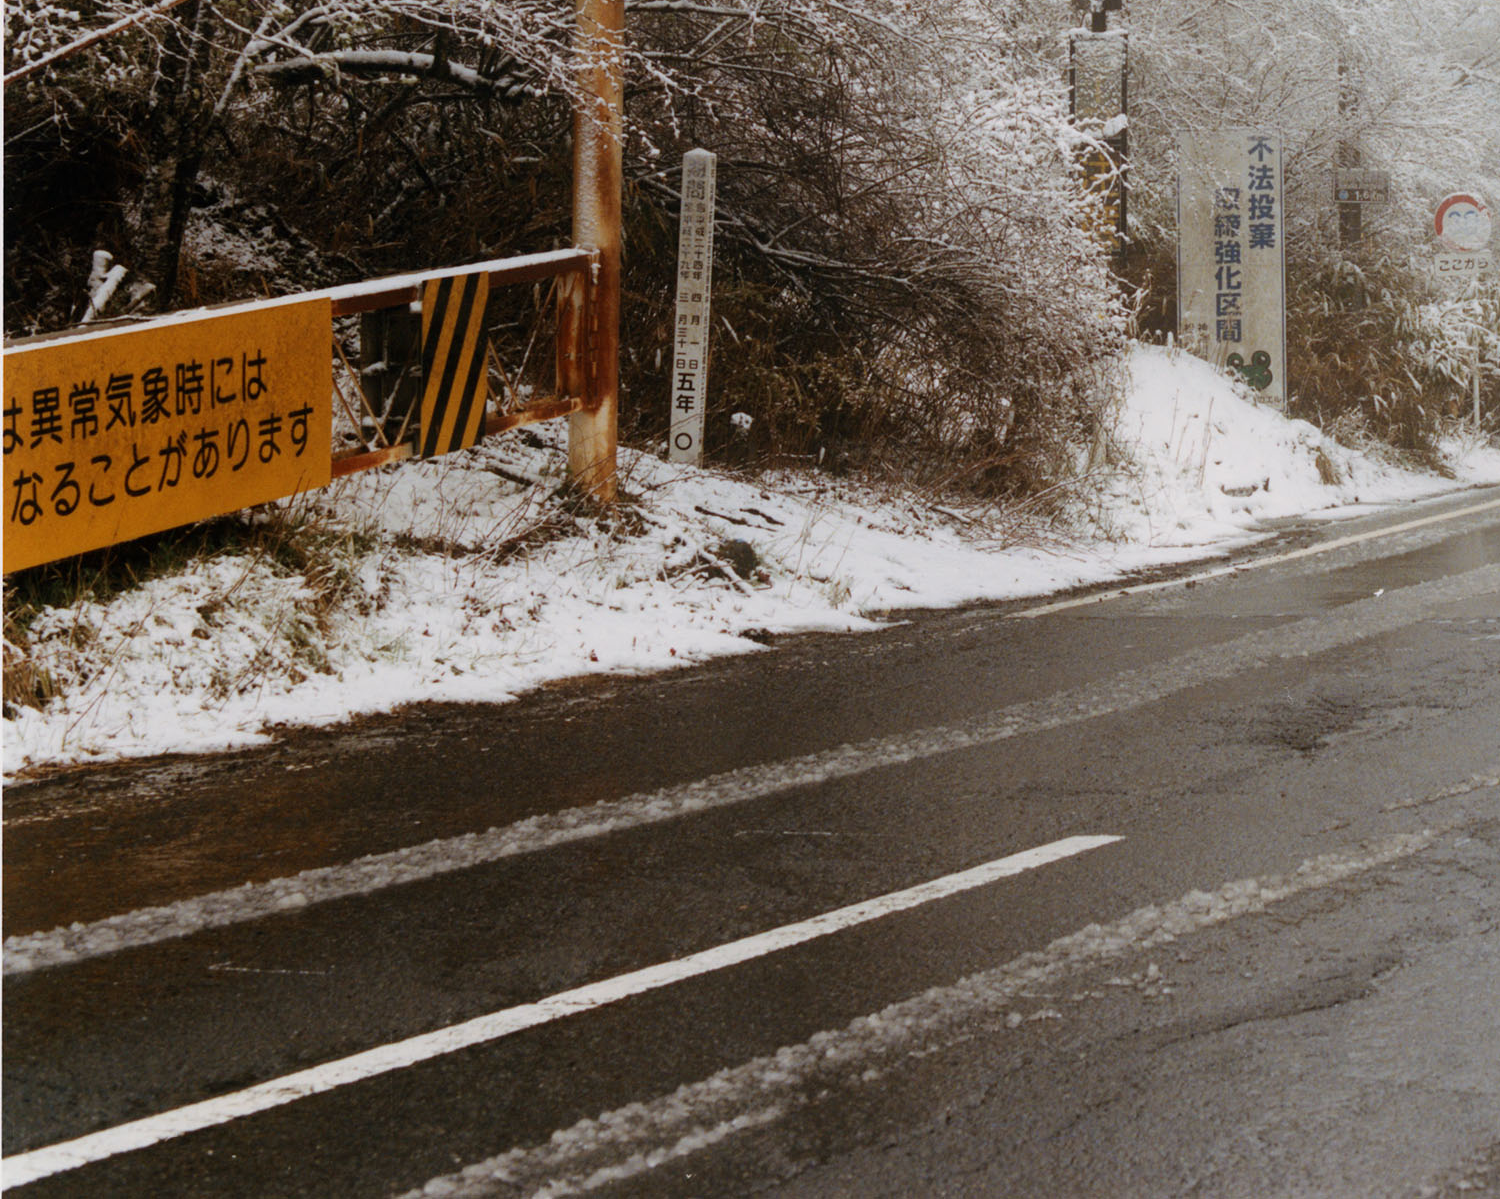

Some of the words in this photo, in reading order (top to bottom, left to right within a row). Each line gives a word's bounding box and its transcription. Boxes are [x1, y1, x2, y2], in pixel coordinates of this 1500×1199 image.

[1247, 135, 1275, 249] 不法投棄
[1439, 257, 1489, 272] ここから
[676, 372, 696, 413] 五年
[11, 401, 314, 526] なることがあります
